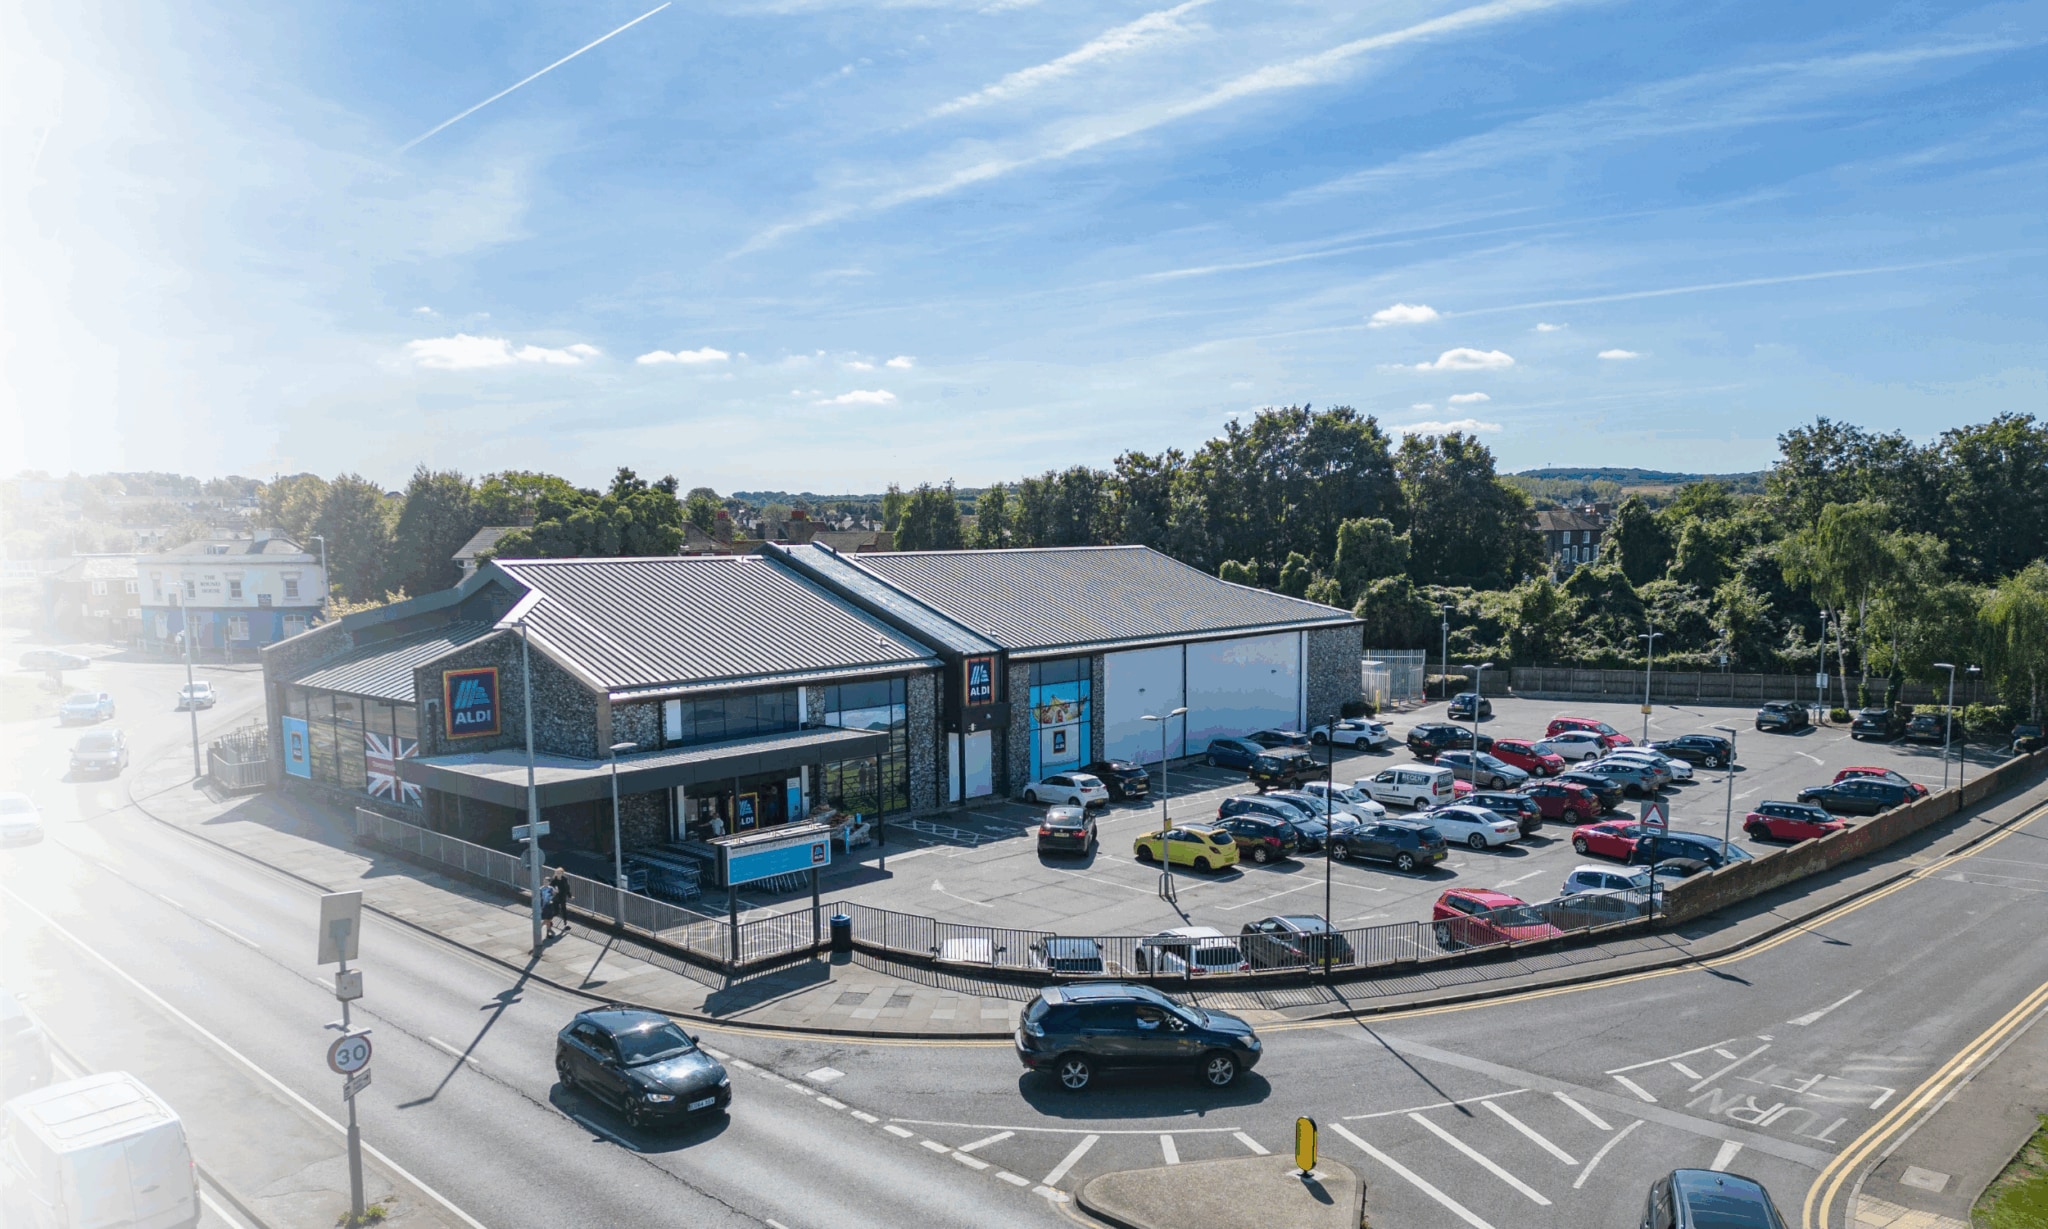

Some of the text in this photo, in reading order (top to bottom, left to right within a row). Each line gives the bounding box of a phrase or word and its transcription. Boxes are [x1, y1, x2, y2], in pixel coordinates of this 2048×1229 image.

[970, 685, 990, 696] ALDI
[455, 709, 491, 725] ALDI
[337, 1044, 366, 1066] 30
[1684, 1087, 1848, 1144] TURN
